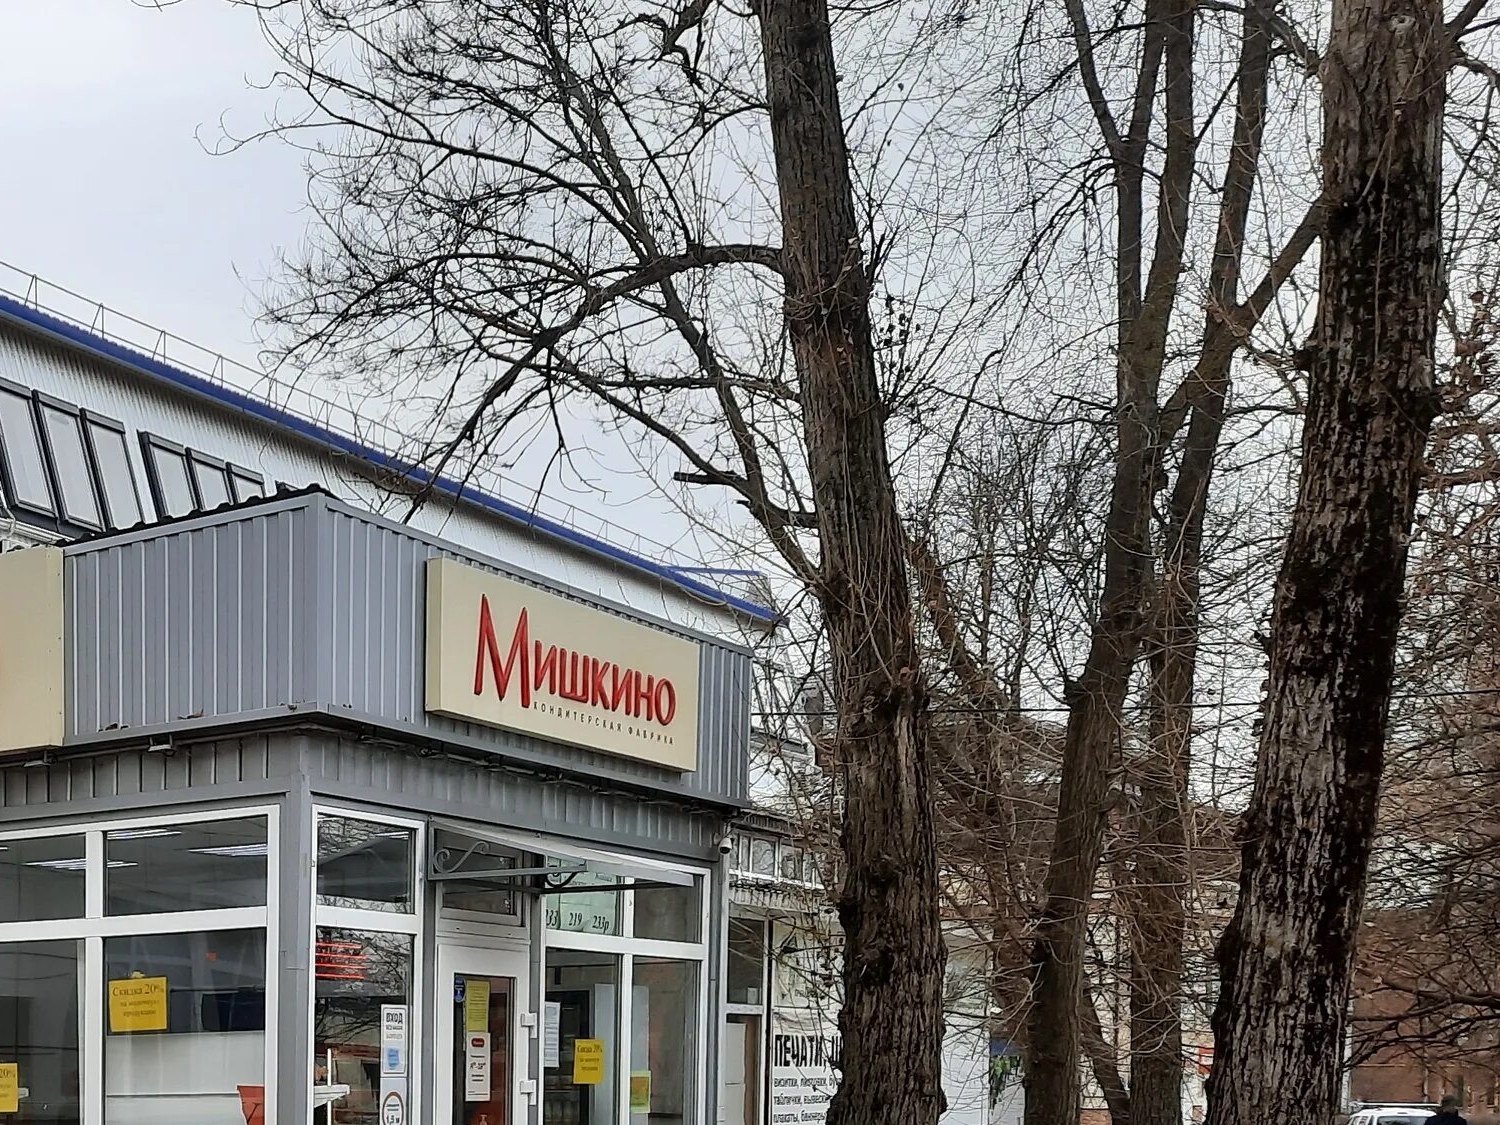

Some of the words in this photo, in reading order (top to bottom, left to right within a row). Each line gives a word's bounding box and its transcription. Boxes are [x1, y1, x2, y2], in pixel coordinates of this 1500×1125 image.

[533, 701, 622, 733] КОНДИТЕРСКАЯ
[628, 726, 674, 745] ФАБРИКА
[568, 912, 582, 926] 219
